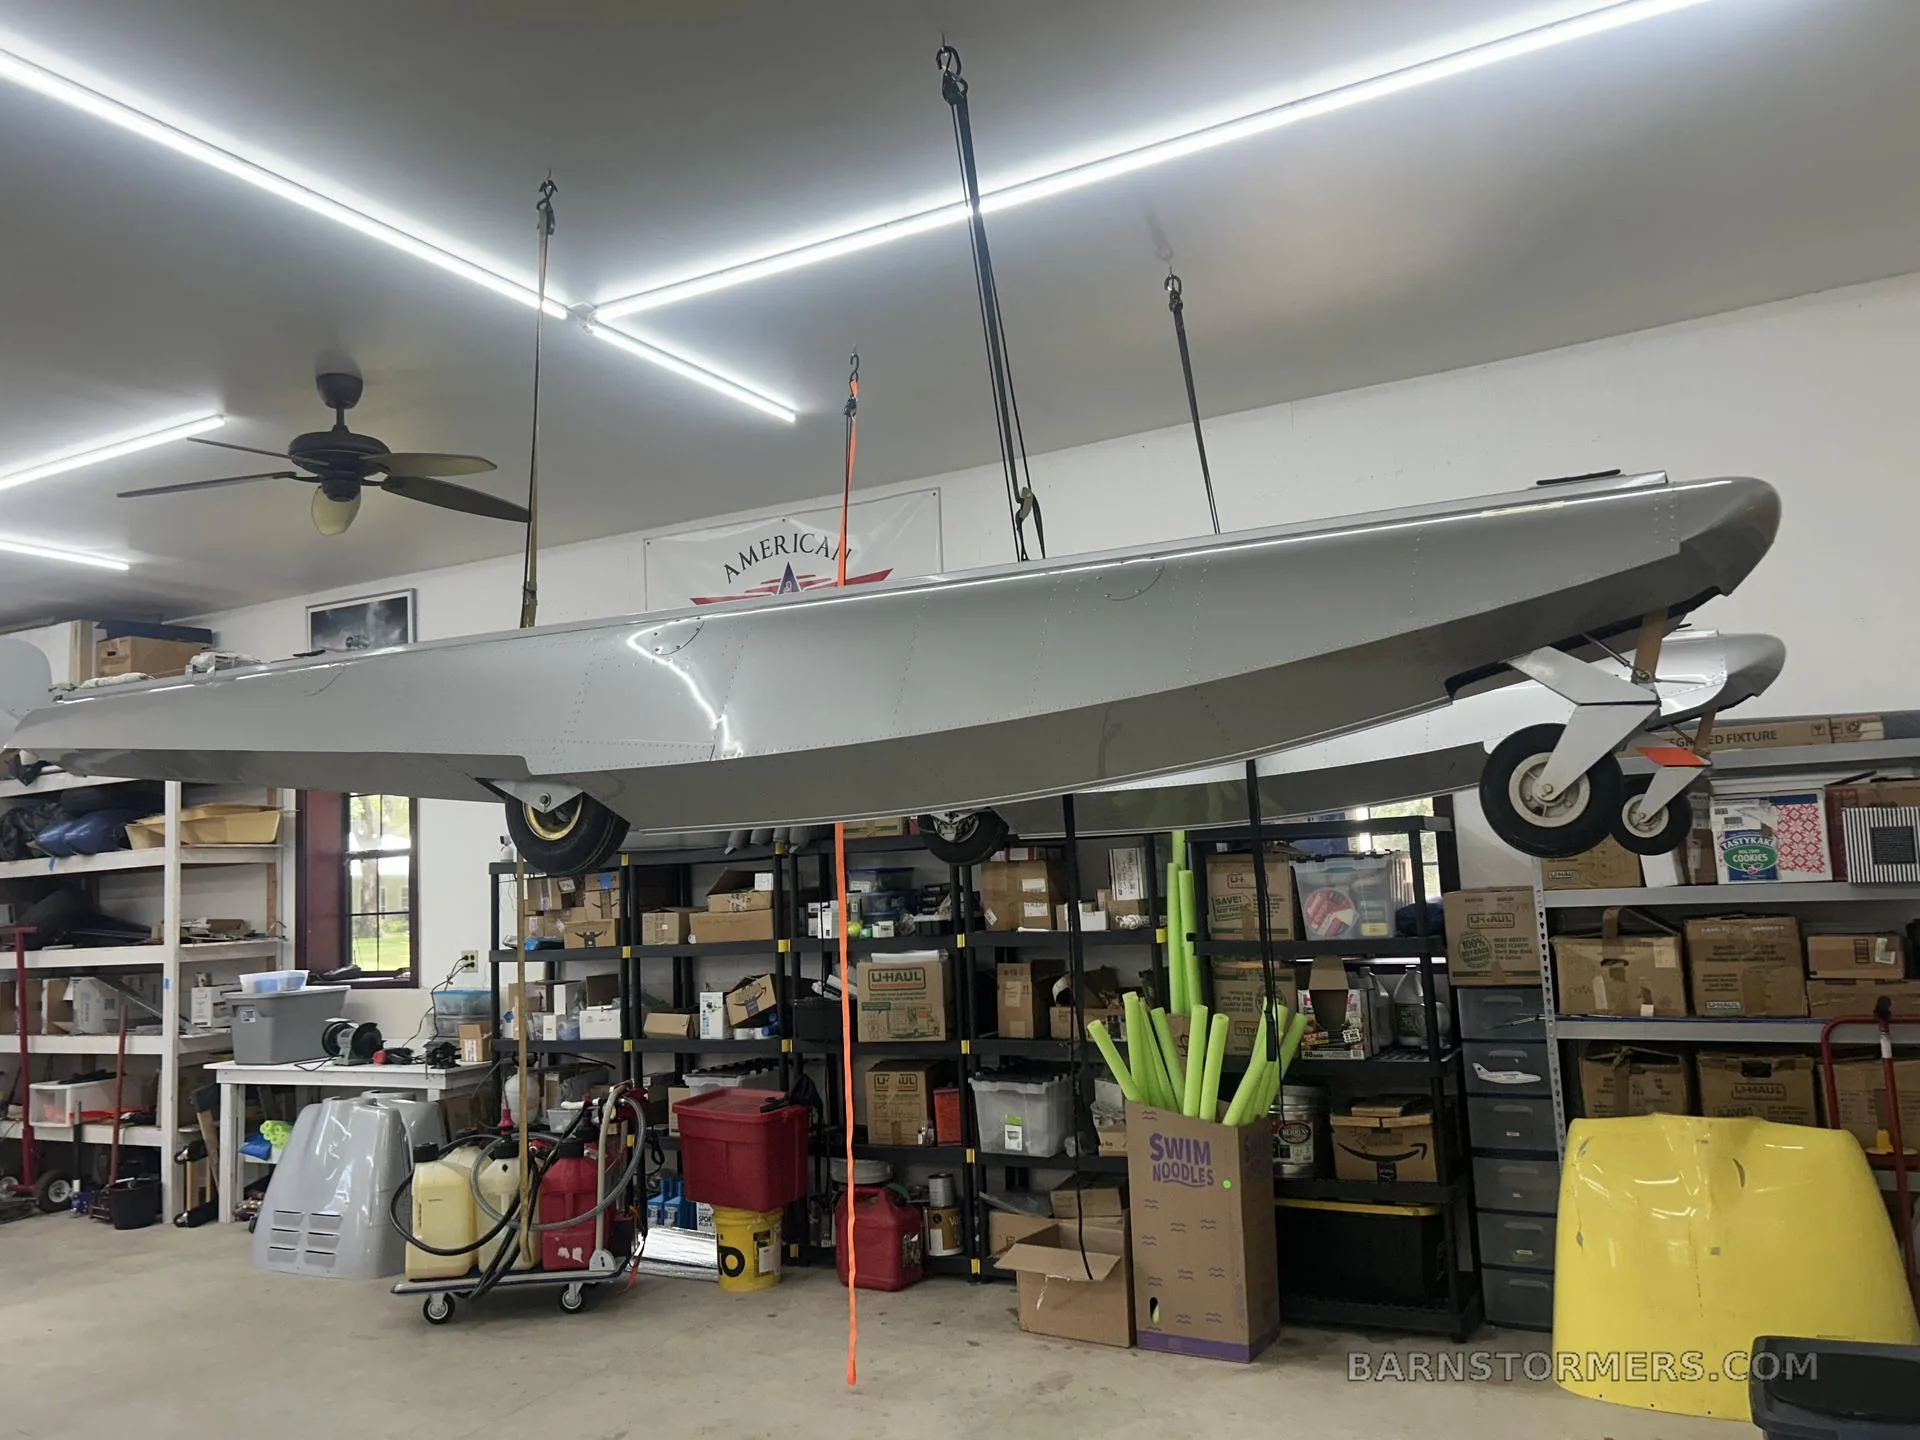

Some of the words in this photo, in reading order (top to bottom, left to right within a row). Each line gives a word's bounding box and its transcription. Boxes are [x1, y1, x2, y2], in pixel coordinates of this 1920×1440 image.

[723, 532, 852, 585] AMERICAN
[1726, 729, 1778, 744] FIXTURE
[1731, 853, 1769, 863] COOKIES
[871, 971, 922, 983] U-HAUL
[1734, 1085, 1783, 1094] U-HAUL
[1149, 1132, 1212, 1166] SWIM
[1152, 1162, 1214, 1187] NOODLES
